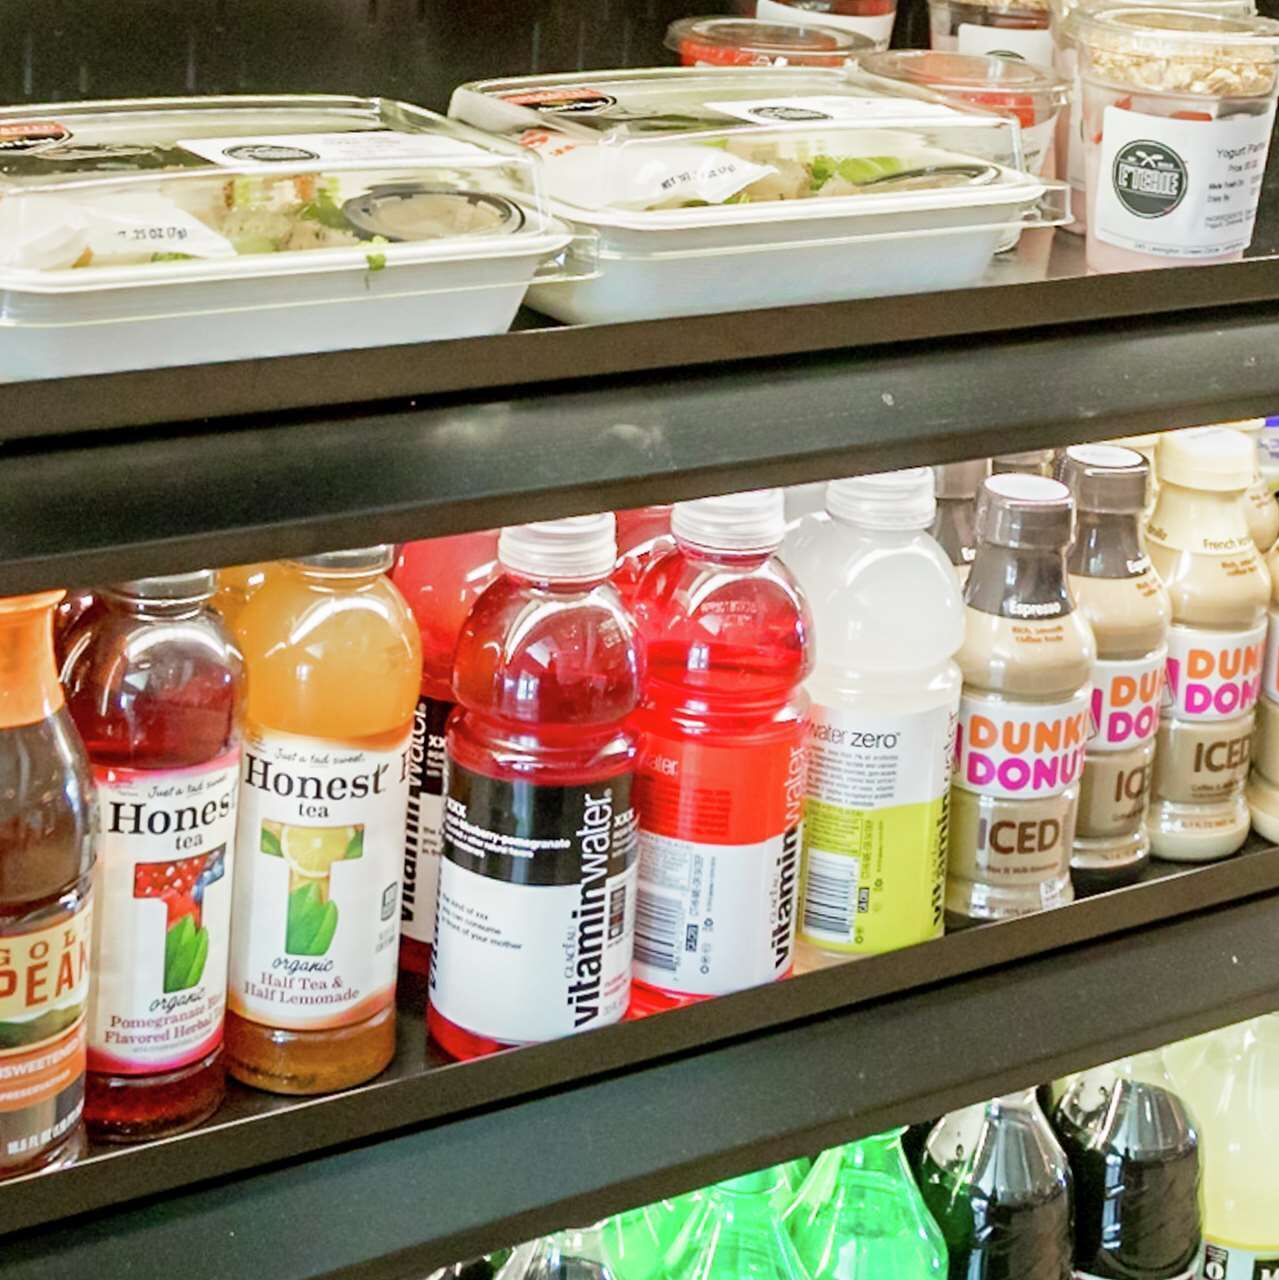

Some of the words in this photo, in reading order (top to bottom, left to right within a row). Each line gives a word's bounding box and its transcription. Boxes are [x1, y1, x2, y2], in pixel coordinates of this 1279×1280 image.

[1010, 600, 1061, 617] Espresso
[245, 753, 389, 800] Honest
[148, 786, 175, 798] Just
[298, 804, 330, 818] tea
[176, 834, 203, 851] tea
[568, 793, 612, 1028] vitaminwater
[272, 958, 333, 973] organic
[260, 972, 293, 989] Half
[298, 978, 327, 990] Tea
[332, 976, 344, 988] &
[149, 987, 205, 1014] organic
[245, 981, 276, 1001] Half
[280, 988, 361, 1005] Lemonade
[105, 1024, 170, 1044] Flavored
